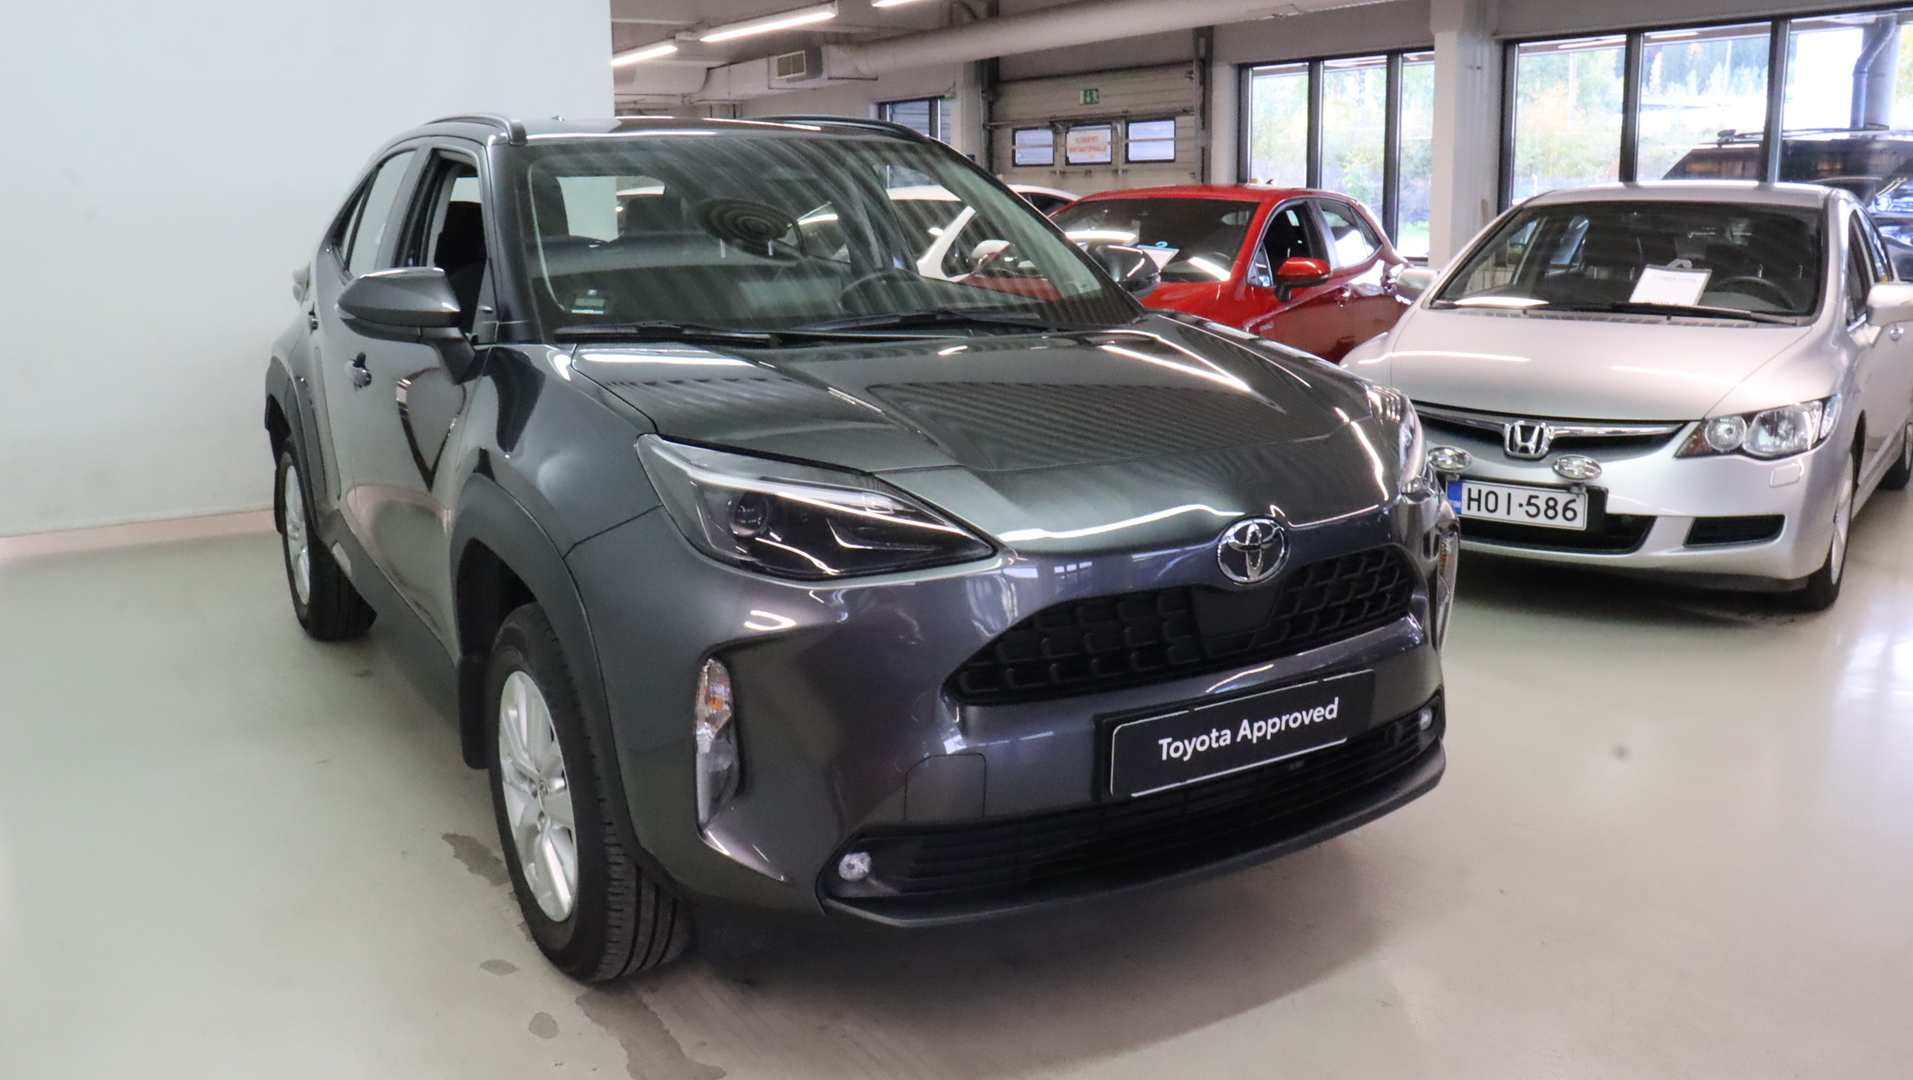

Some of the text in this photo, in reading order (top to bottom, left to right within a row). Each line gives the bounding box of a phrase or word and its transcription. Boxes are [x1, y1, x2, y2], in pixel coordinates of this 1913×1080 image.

[1466, 487, 1578, 522] HOI-586
[1158, 696, 1339, 761] Toyota Approved
